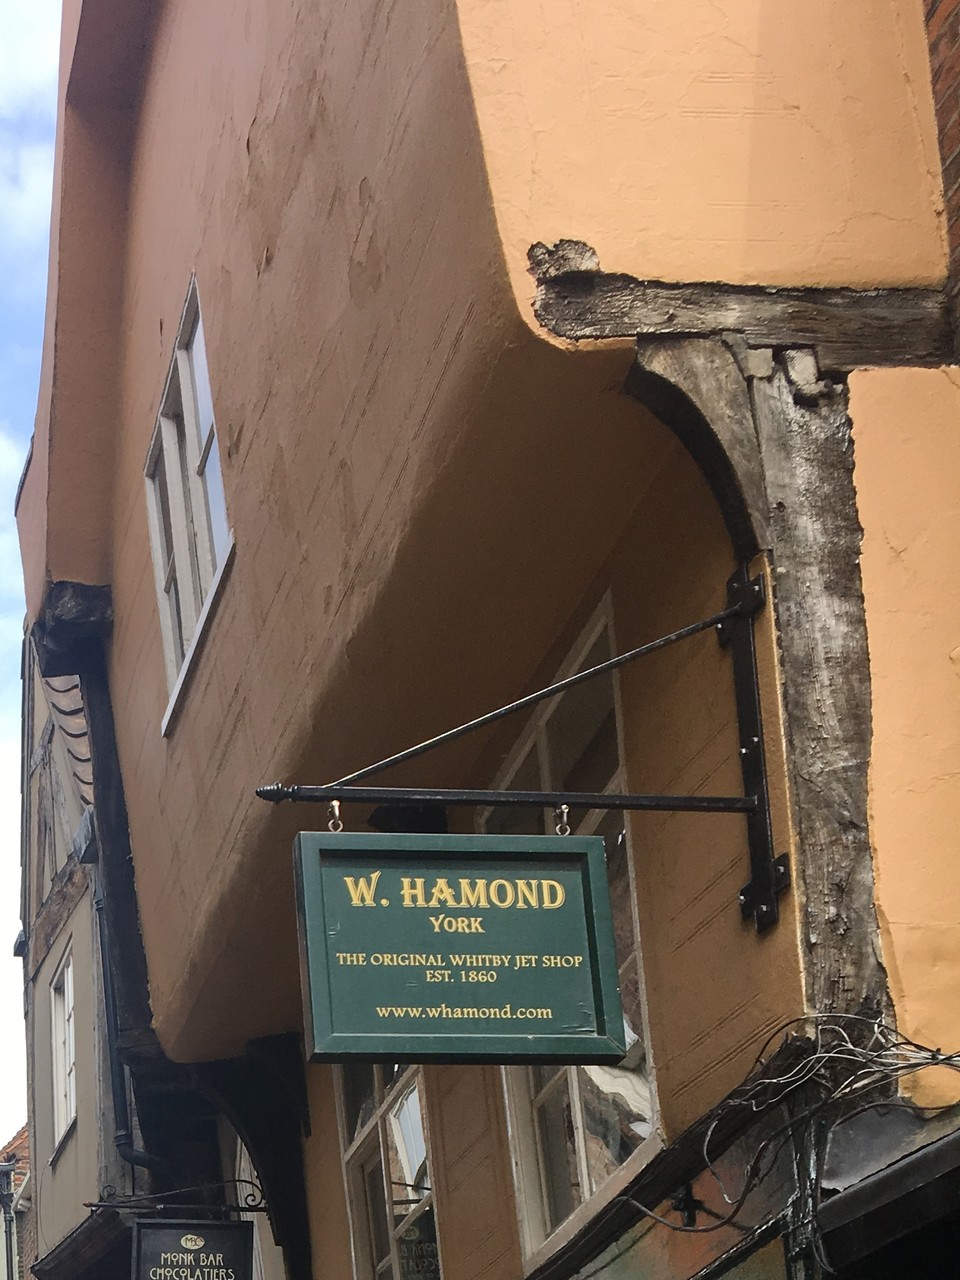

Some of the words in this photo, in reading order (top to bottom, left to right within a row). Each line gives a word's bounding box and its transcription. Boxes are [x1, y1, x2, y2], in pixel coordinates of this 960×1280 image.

[344, 870, 389, 907] W.
[400, 877, 566, 909] HAMOND
[429, 914, 485, 933] YORK
[336, 953, 367, 966] THE
[370, 953, 446, 967] ORIGINAL
[449, 954, 511, 969] WHITBY
[514, 955, 539, 970] JET
[542, 955, 583, 969] SHOP
[425, 970, 454, 983] EST.
[459, 970, 497, 983] 1860
[376, 1004, 553, 1020] www.whamond.com
[161, 1252, 195, 1266] MONK
[200, 1253, 224, 1266] BAR
